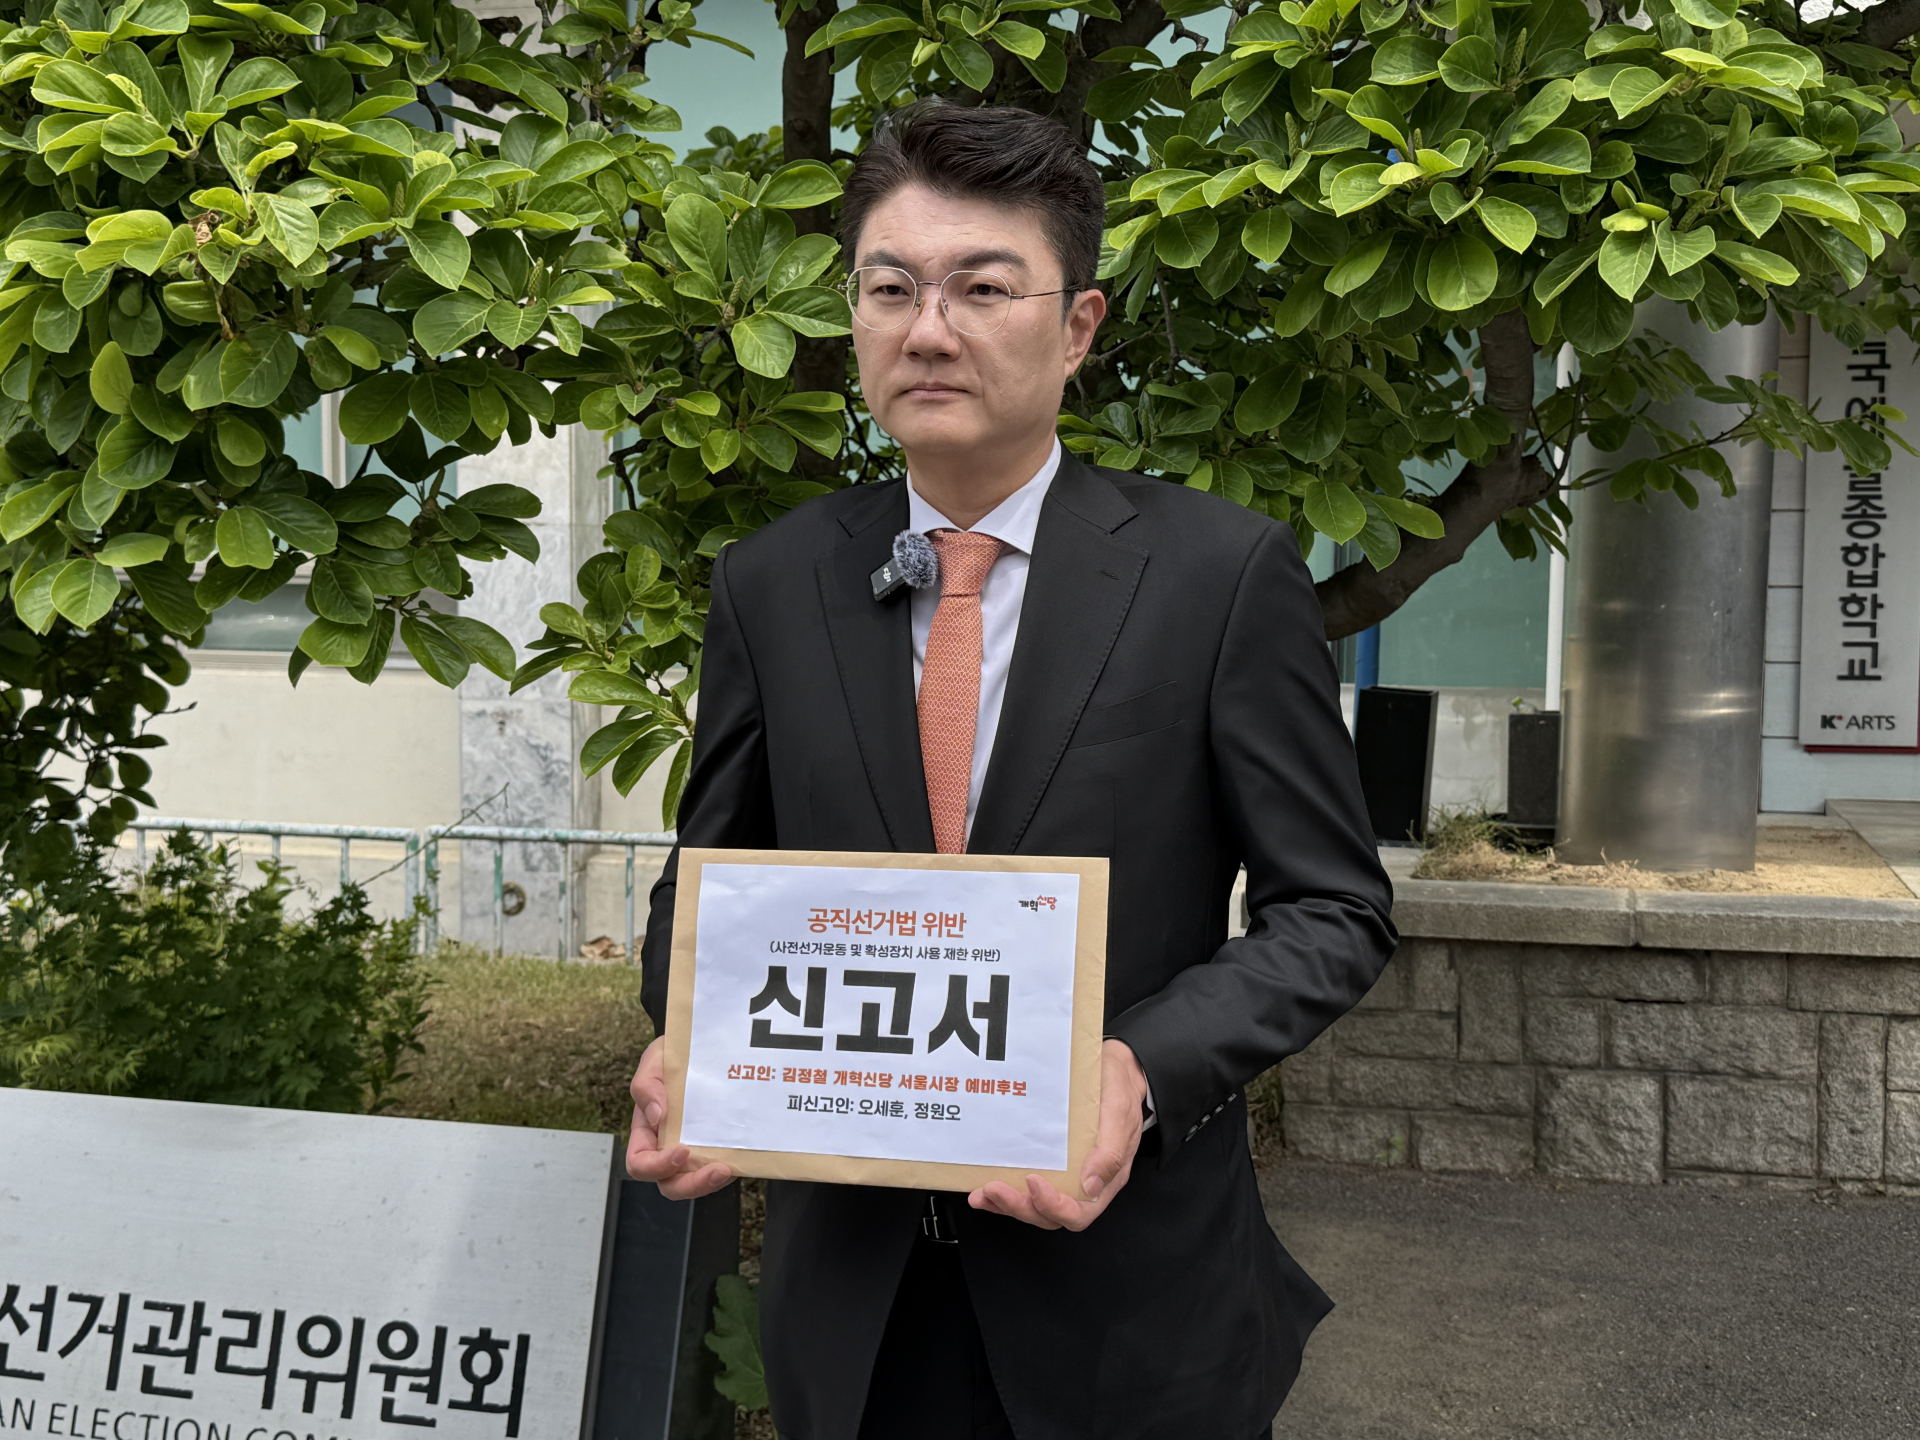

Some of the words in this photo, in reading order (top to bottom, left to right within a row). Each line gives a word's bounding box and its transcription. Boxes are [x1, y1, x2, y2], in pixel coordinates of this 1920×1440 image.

[1836, 302, 1891, 682] 국예종합학교
[807, 907, 917, 937] 공직선거법
[921, 911, 968, 939] 위반
[769, 940, 847, 958] (사전선거운동
[850, 943, 863, 957] 및
[864, 943, 913, 960] 확성장치
[915, 946, 941, 961] 사용
[942, 947, 969, 962] 제한
[970, 948, 1001, 963] 위반)
[748, 965, 1011, 1062] 신고서
[727, 1064, 777, 1082] 신고인:
[782, 1067, 828, 1086] 김정철
[833, 1070, 894, 1089] 개혁신당
[898, 1074, 960, 1093] 서울시장
[965, 1078, 1027, 1097] 예비후보
[786, 1094, 855, 1115] 피신고인:
[857, 1099, 909, 1120] 오세훈,
[913, 1102, 961, 1122] 정원오
[0, 1283, 532, 1438] 선거관리위원회
[0, 1397, 36, 1431] N
